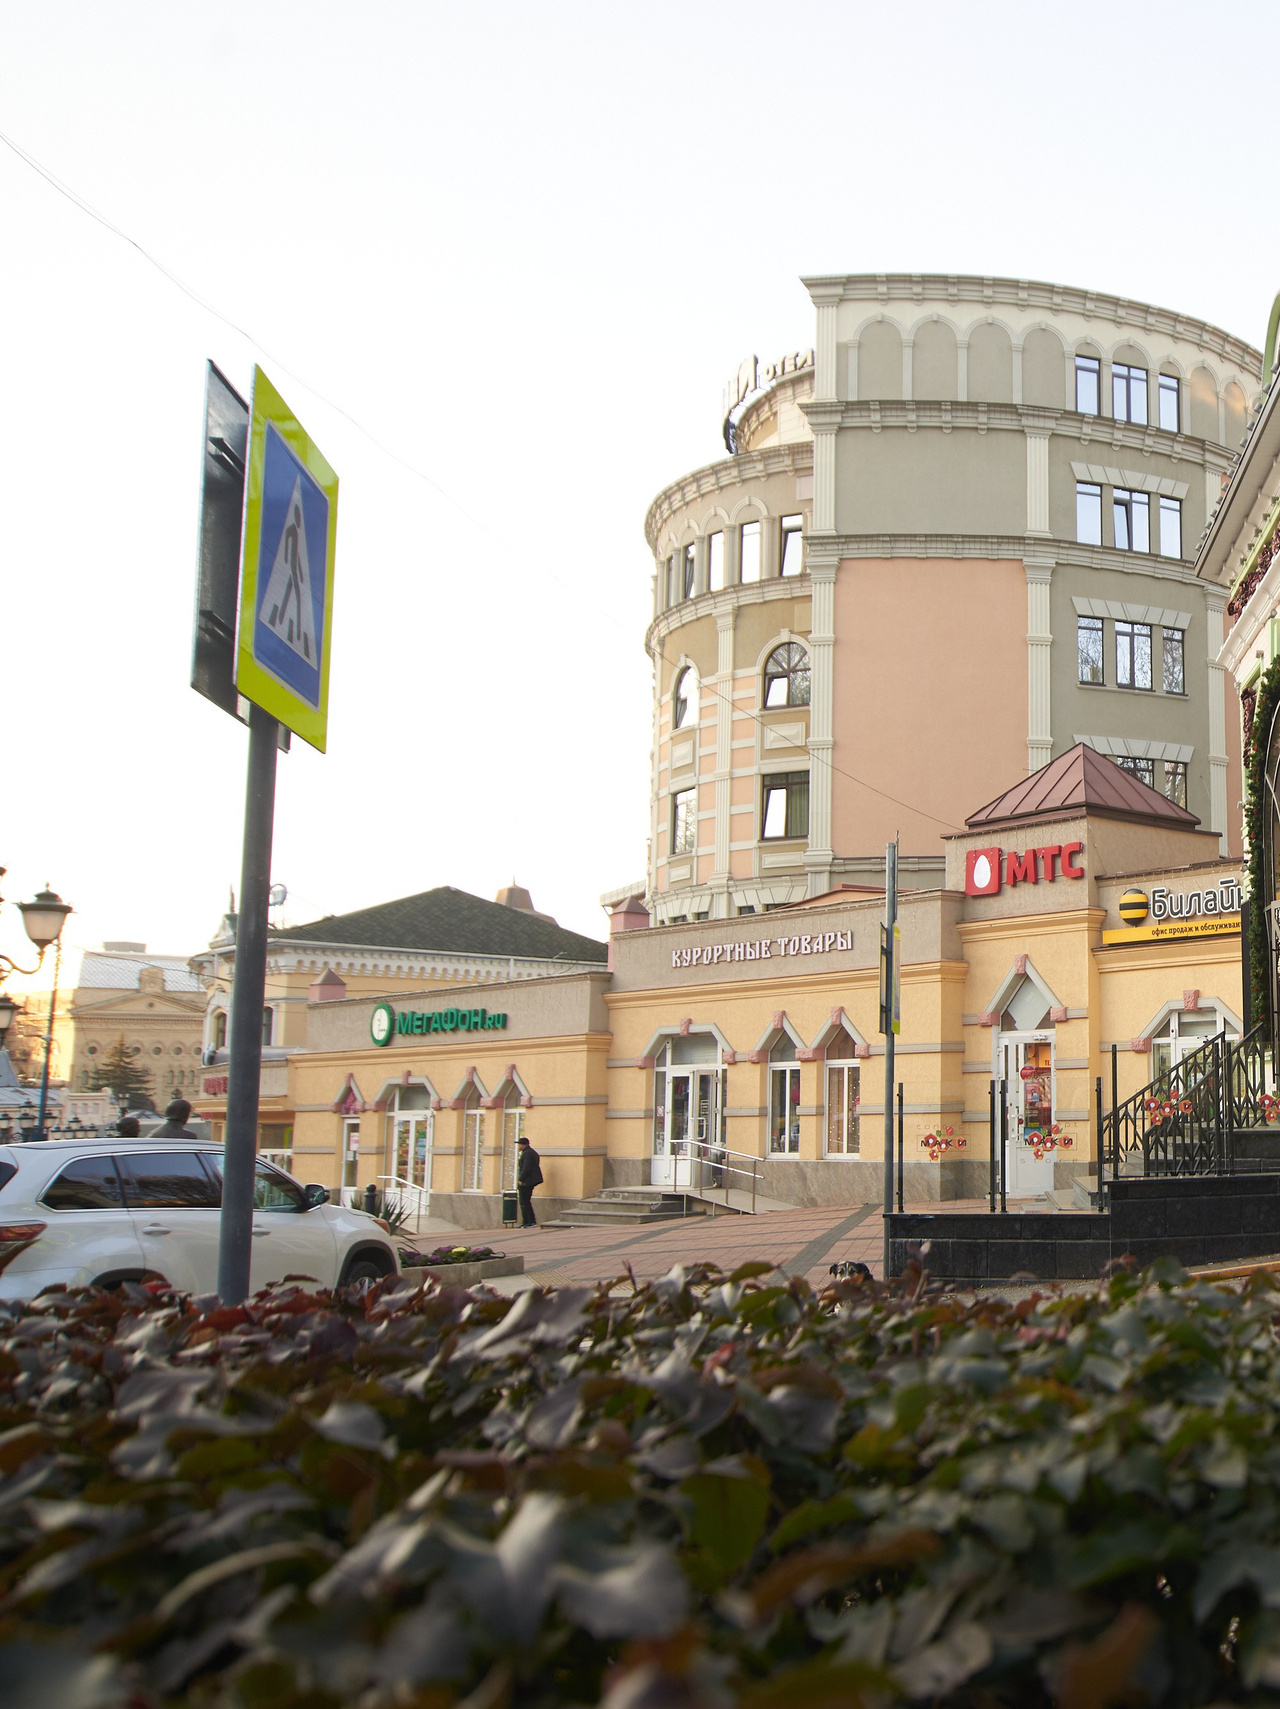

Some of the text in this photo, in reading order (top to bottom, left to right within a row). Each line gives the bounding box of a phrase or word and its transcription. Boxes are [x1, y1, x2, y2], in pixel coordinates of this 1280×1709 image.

[1006, 841, 1084, 885] МТС
[1152, 928, 1167, 936] офис
[1169, 926, 1193, 935] продаж
[1201, 922, 1241, 931] обслуживан
[672, 930, 853, 968] КУРОРТНЫЕ ТОВАРЫ
